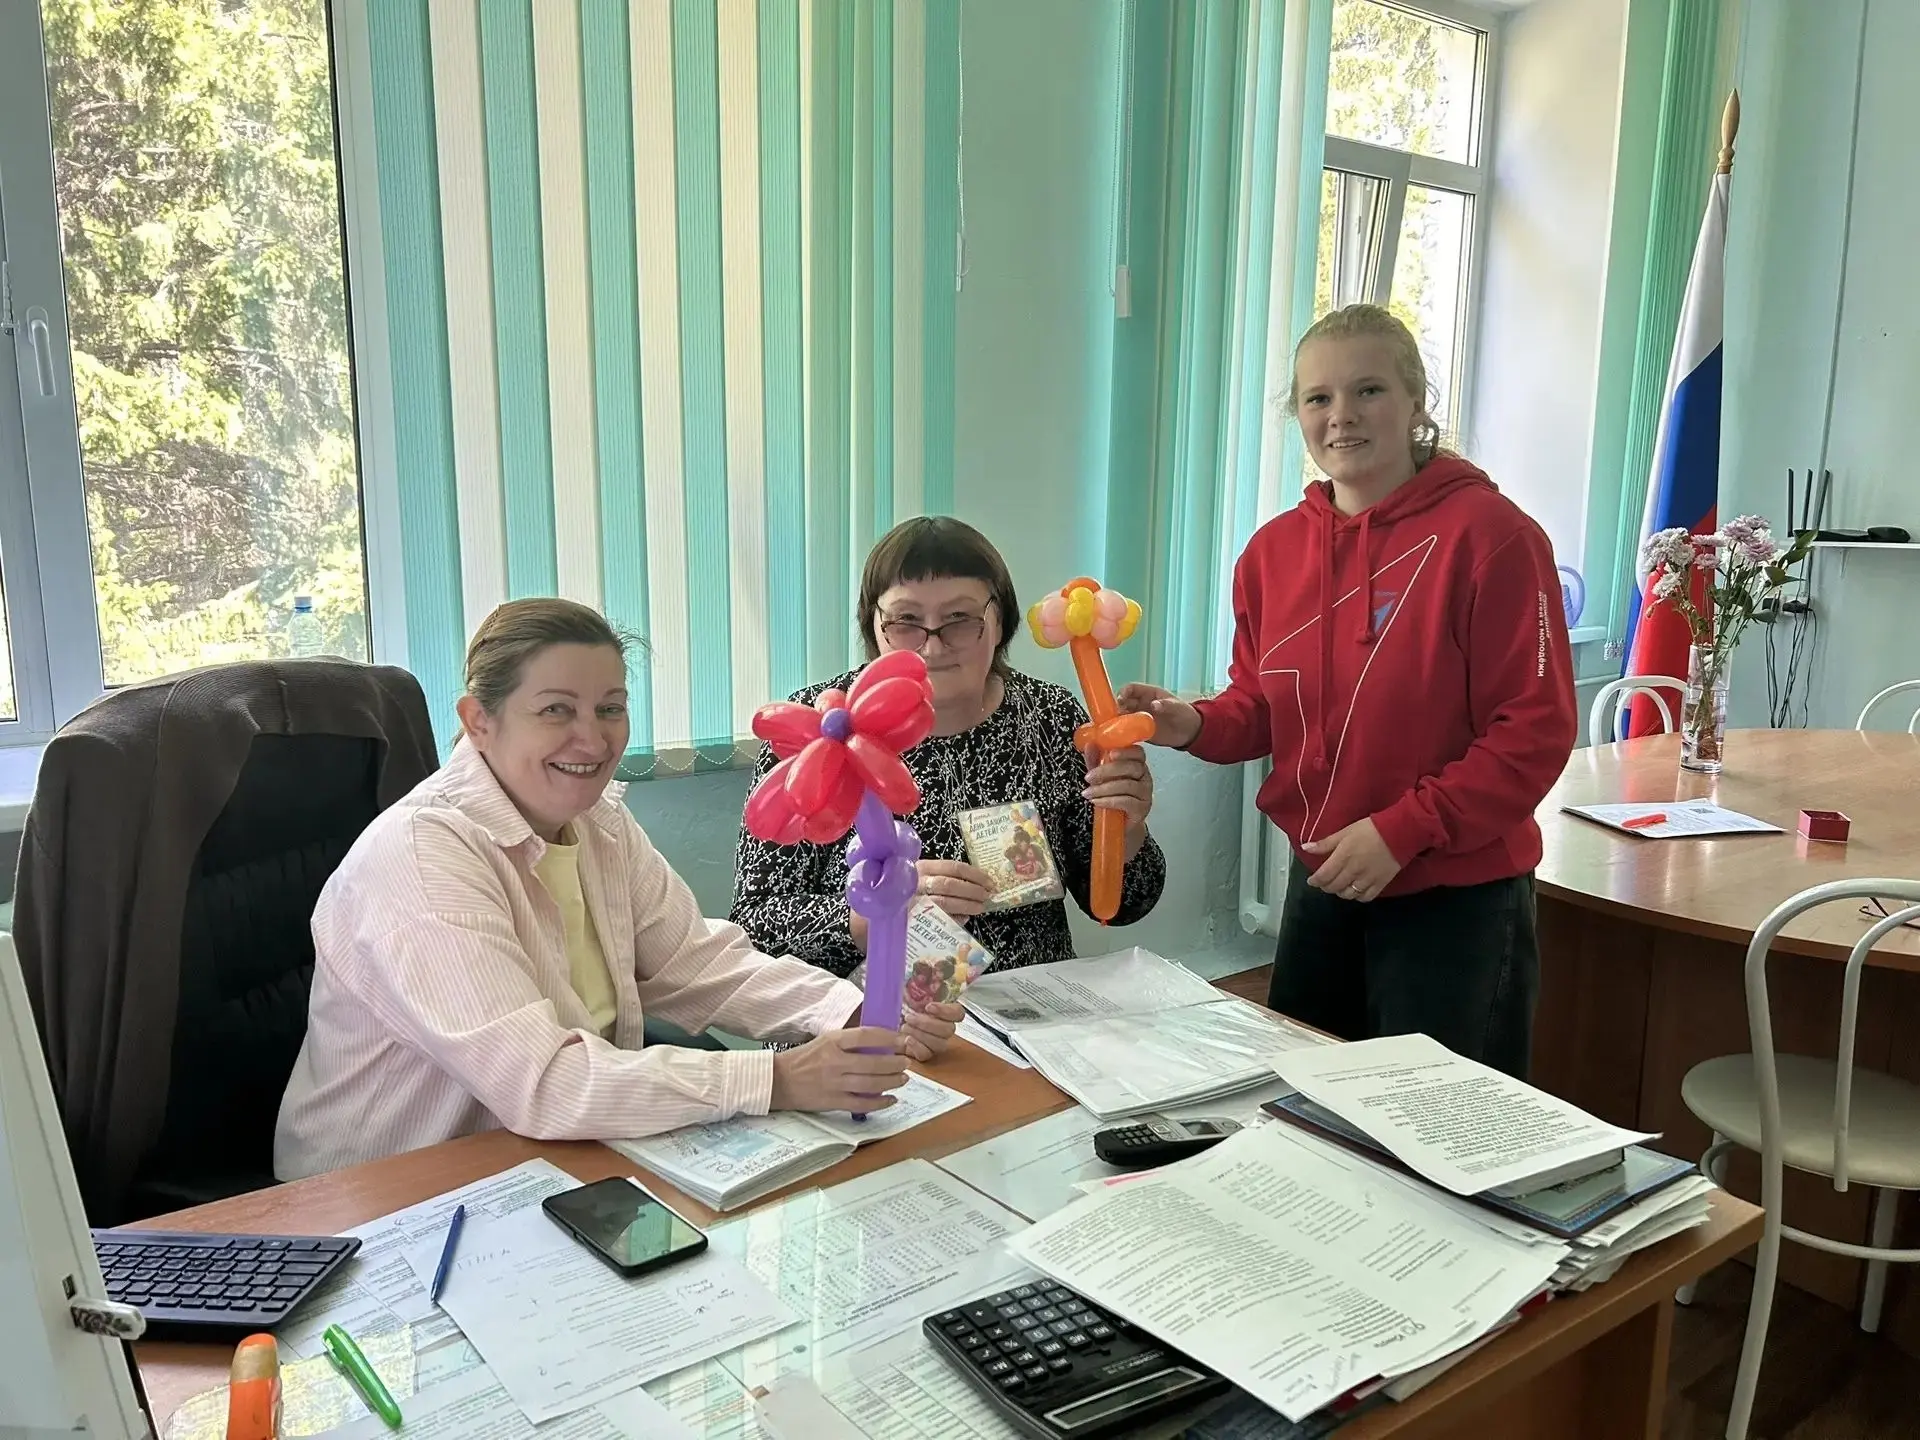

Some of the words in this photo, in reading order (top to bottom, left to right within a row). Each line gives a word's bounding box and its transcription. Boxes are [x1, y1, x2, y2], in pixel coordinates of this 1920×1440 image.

[1537, 628, 1546, 677] молодёжи
[969, 821, 985, 833] ДЕНЬ
[987, 814, 1010, 825] ЗАЩИТЫ
[913, 914, 932, 928] ДЕНЬ
[934, 925, 960, 946] ЗАЩИТЫ
